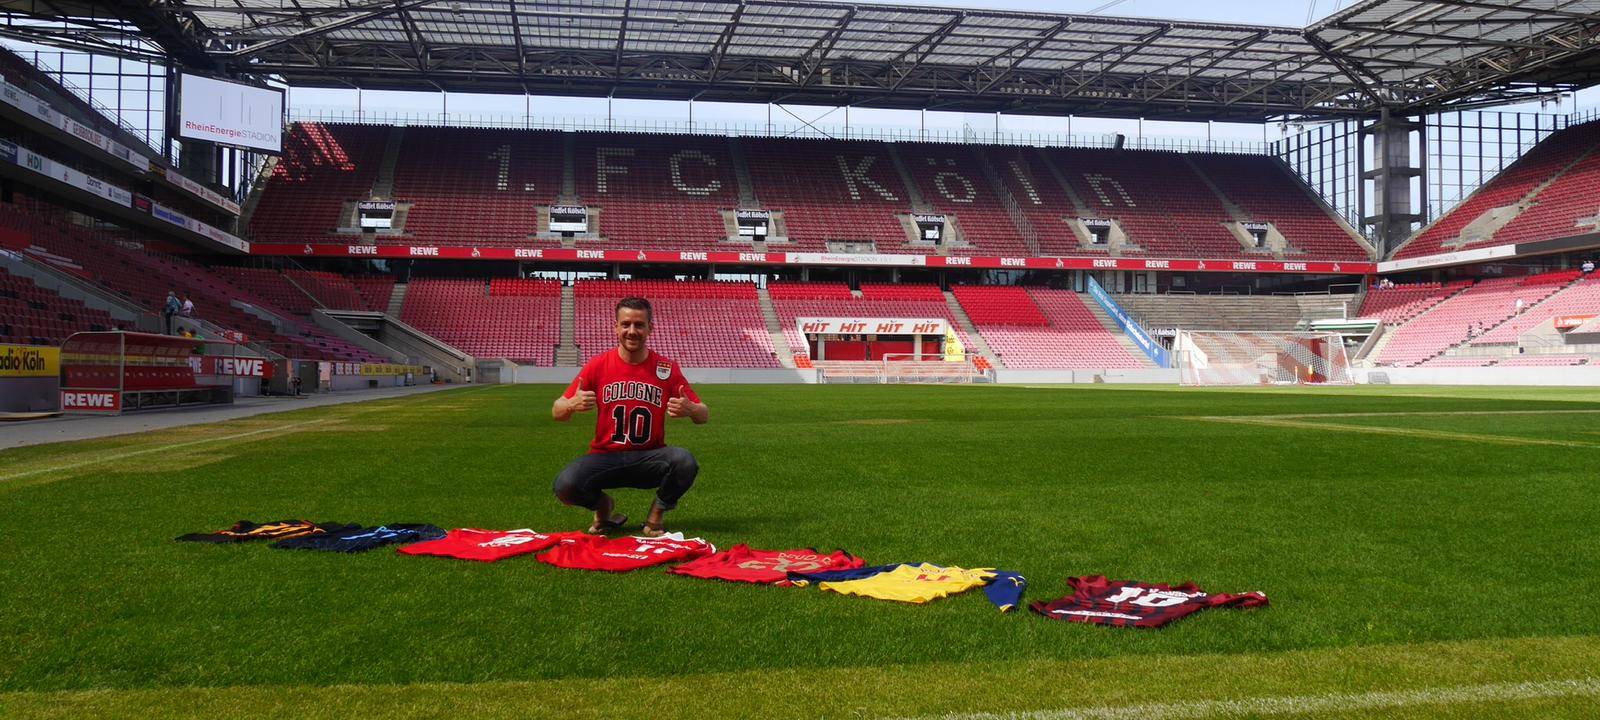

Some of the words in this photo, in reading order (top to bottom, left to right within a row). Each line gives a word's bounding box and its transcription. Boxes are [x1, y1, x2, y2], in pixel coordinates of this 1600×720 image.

[185, 121, 277, 143] RheinEnergieSTADION
[27, 153, 42, 171] HDI
[596, 147, 721, 195] FC
[348, 245, 377, 255] REWE
[410, 246, 439, 256] REWE
[514, 249, 543, 258] REWE
[576, 250, 605, 259] REWE
[680, 251, 708, 261] REWE
[739, 252, 767, 262] REWE
[945, 256, 971, 266] REWE
[1000, 258, 1026, 267] REWE
[1093, 259, 1118, 268] REWE
[1145, 260, 1169, 269] REWE
[1232, 261, 1257, 271] REWE
[1283, 262, 1308, 272] REWE
[23, 349, 45, 371] Köln
[602, 380, 663, 408] COLOGNE
[64, 392, 114, 408] REWE
[611, 404, 652, 446] 10
